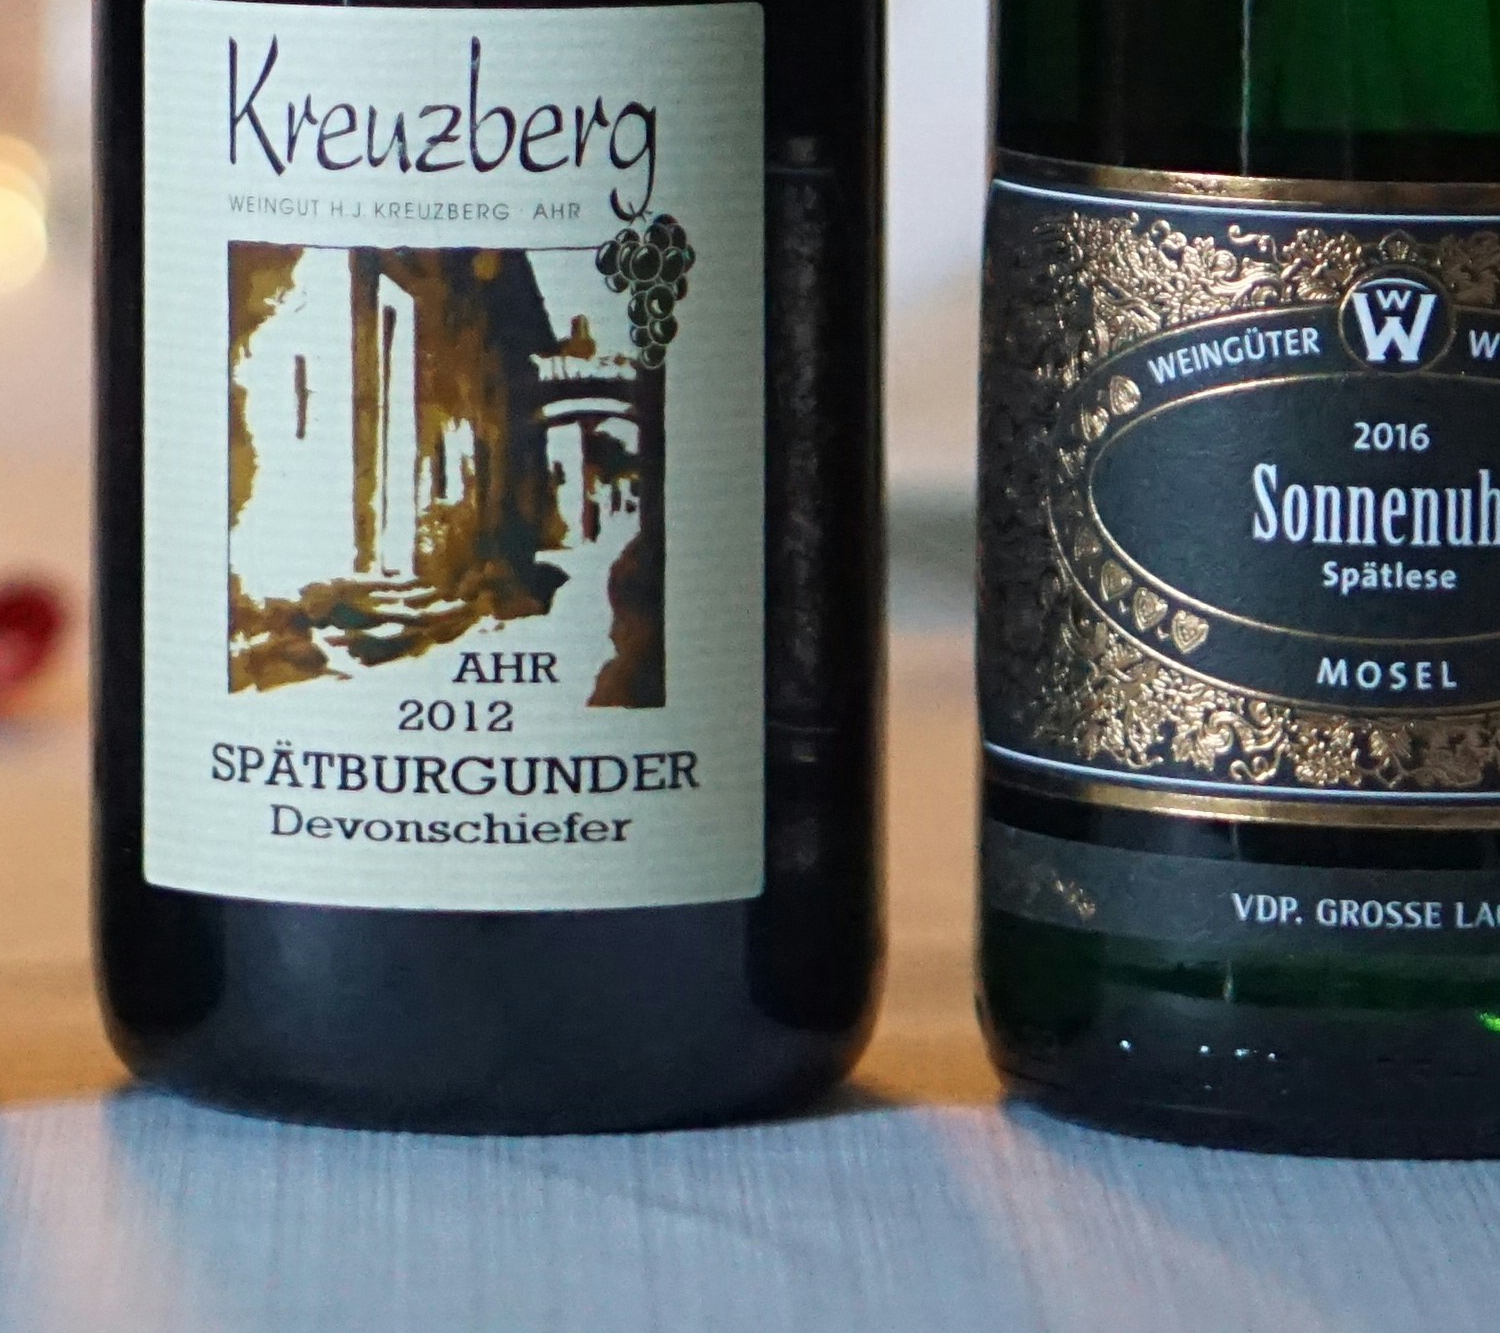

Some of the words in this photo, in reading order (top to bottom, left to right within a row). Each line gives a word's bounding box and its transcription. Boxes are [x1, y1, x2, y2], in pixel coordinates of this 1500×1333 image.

[227, 32, 660, 223] Kreuzberg
[228, 193, 320, 217] WEINGUT
[374, 201, 510, 221] KREUZBERG
[533, 201, 581, 220] AHR
[1148, 325, 1321, 386] WEINGÜTER
[1353, 421, 1431, 452] 2016
[1321, 560, 1458, 594] Spätlese
[452, 650, 560, 686] AHR
[1316, 656, 1459, 691] MOSEL
[398, 699, 515, 733] 2012
[210, 738, 701, 797] SPÄTBURGUNDER
[269, 803, 634, 846] Devonschiefer
[1231, 892, 1303, 926] VDP.
[1315, 897, 1443, 930] GROSSE
